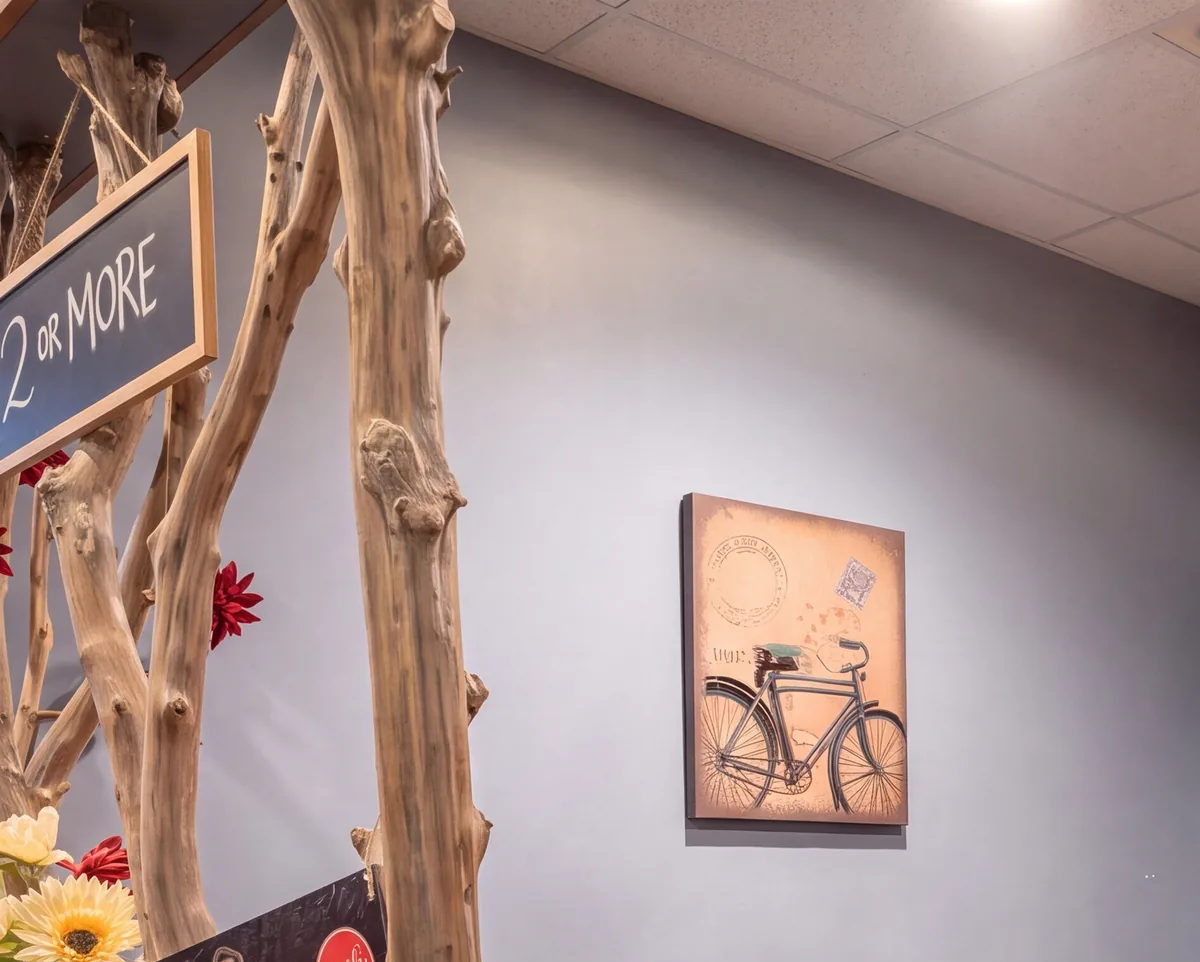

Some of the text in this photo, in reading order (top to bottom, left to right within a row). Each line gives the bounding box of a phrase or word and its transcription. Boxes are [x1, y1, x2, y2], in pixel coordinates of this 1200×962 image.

[0, 232, 157, 424] 2 OR MORE
